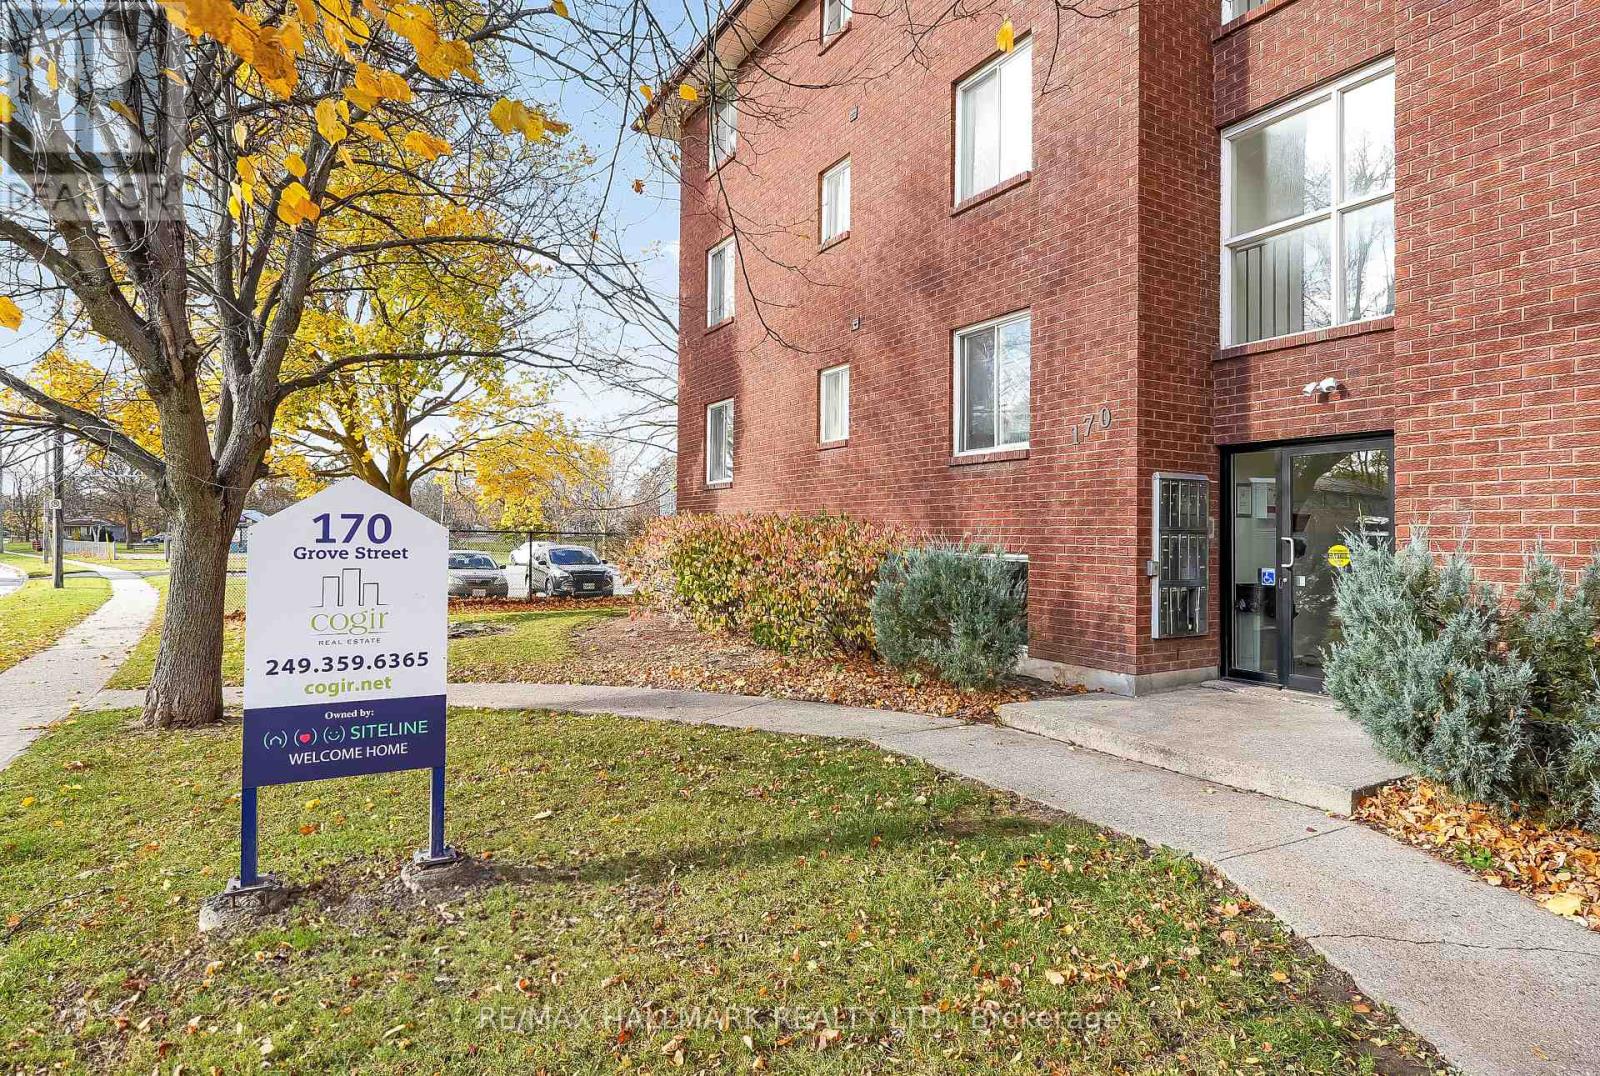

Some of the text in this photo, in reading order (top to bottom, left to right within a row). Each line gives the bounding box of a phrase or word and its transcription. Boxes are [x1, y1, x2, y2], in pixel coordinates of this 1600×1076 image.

[1071, 406, 1112, 446] 170
[312, 513, 392, 544] 170
[293, 546, 409, 560] Grove Street
[310, 608, 389, 635] cogir
[347, 637, 382, 645] ESTATE
[265, 651, 429, 676] 249.359.6365
[304, 676, 393, 697] cogir.net
[324, 709, 375, 720] Owned by:
[350, 720, 429, 740] SITELINE
[288, 743, 409, 766] WELCOME HOME
